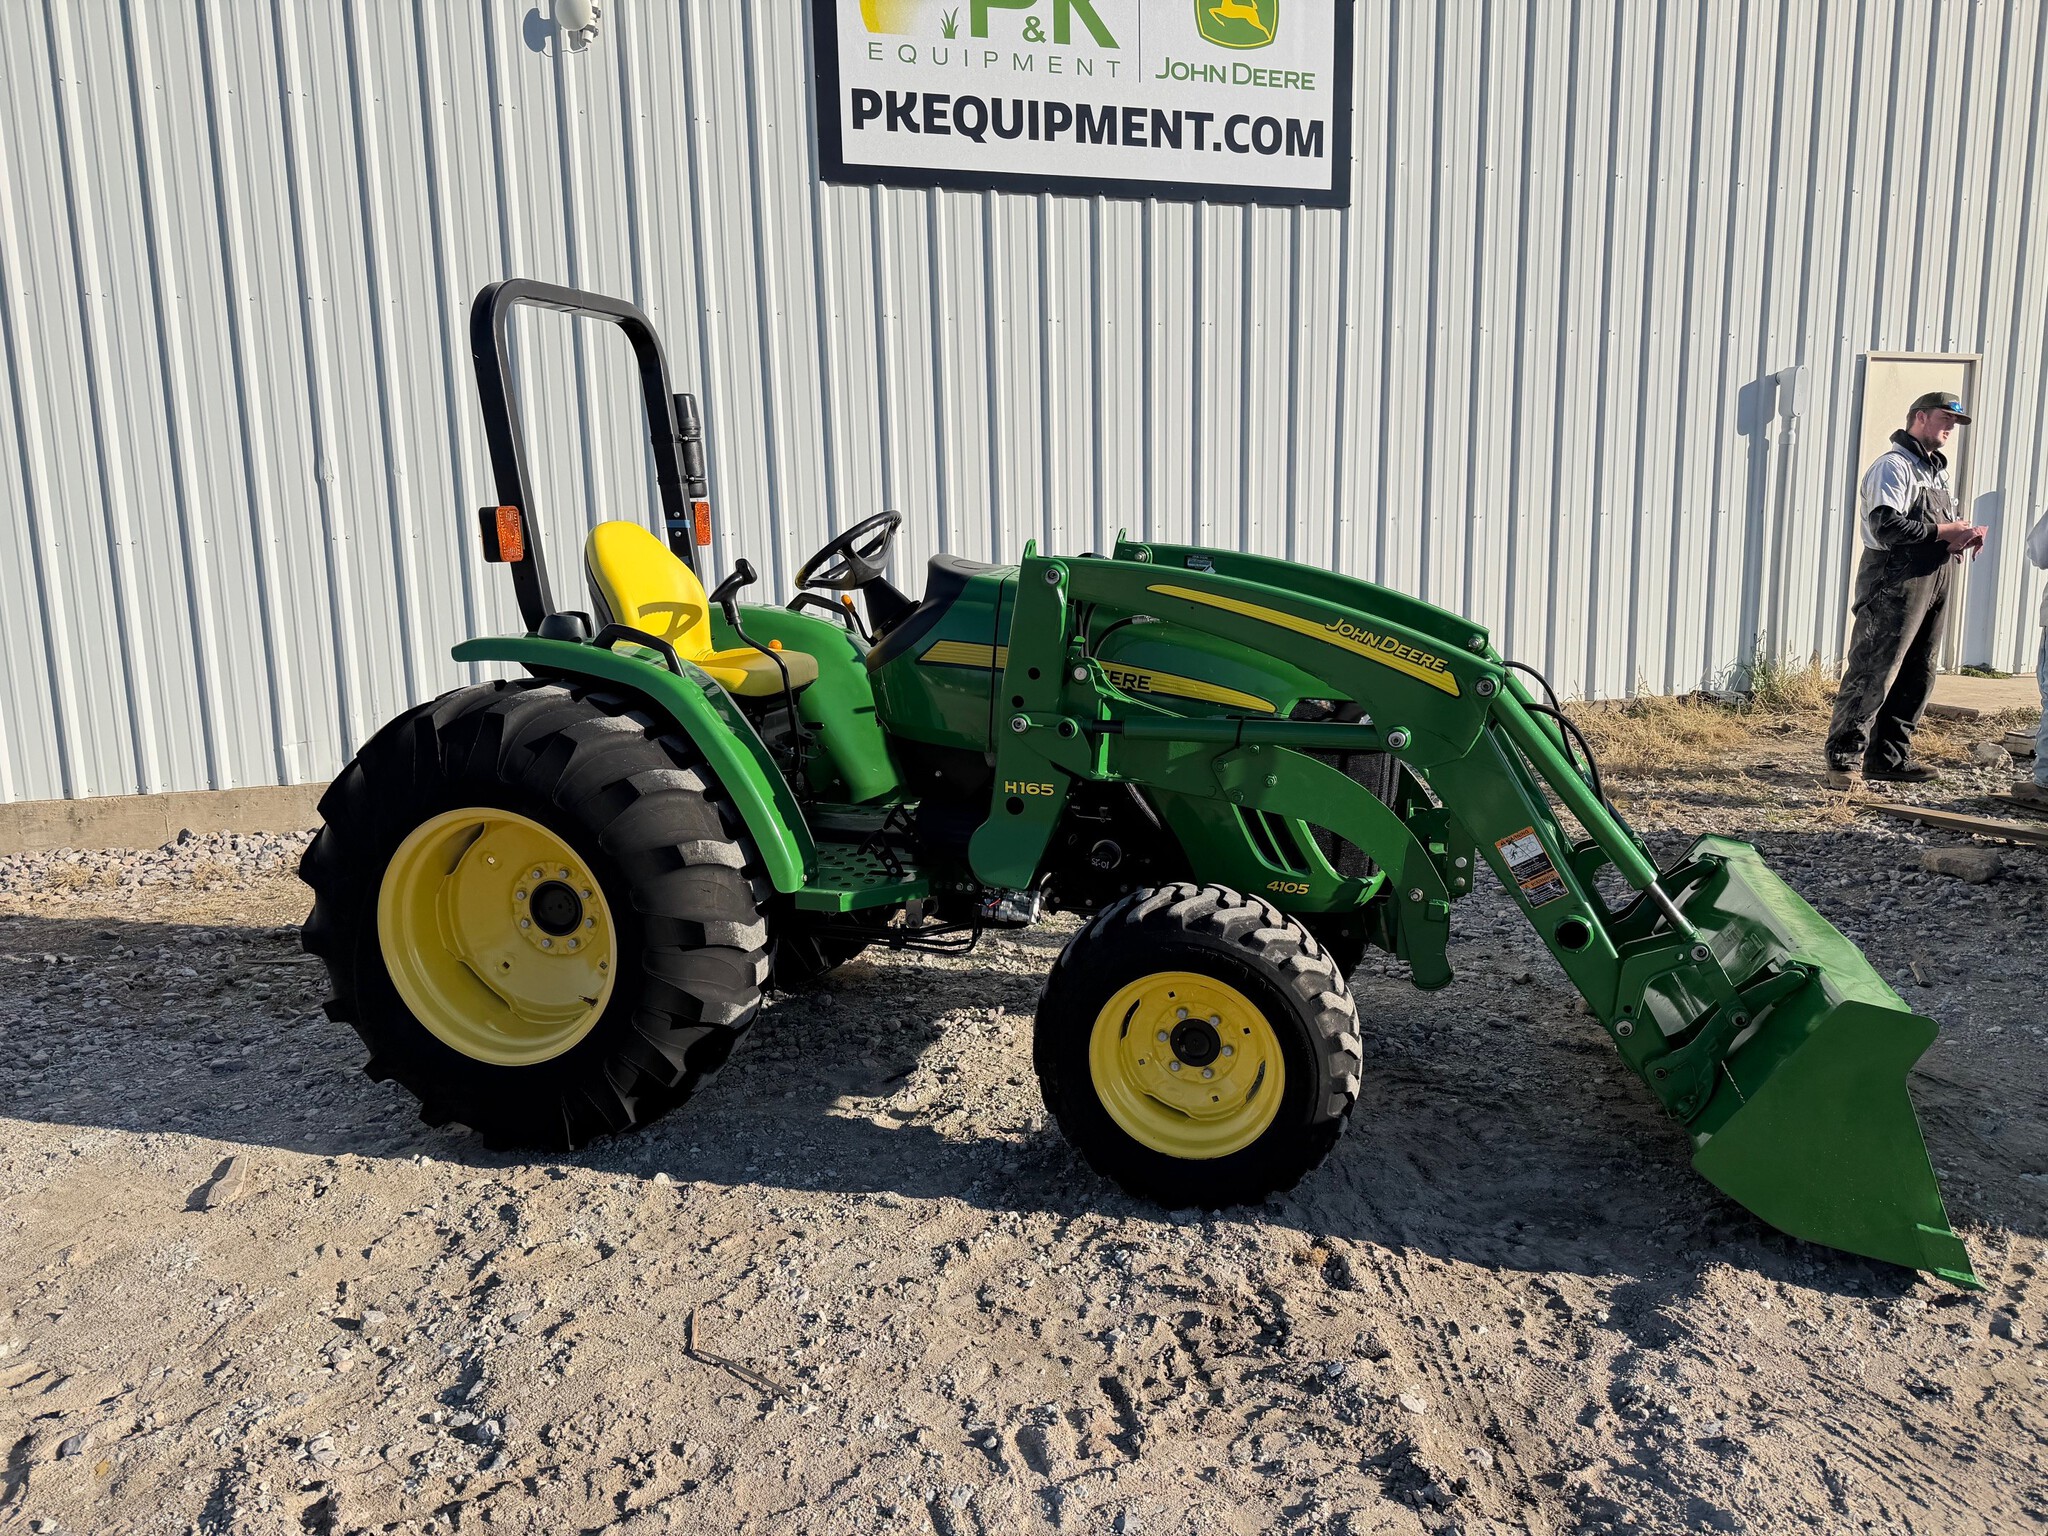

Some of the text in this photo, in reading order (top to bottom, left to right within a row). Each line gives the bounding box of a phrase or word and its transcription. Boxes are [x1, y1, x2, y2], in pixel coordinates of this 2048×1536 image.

[867, 41, 1121, 79] EQUIPMENT
[1154, 56, 1316, 91] JOHN DEERE
[850, 87, 1324, 158] PKEQUIPMENT.COM
[1325, 617, 1450, 674] JOHN DEERE
[1003, 780, 1055, 796] H165
[1266, 880, 1310, 895] 4105
